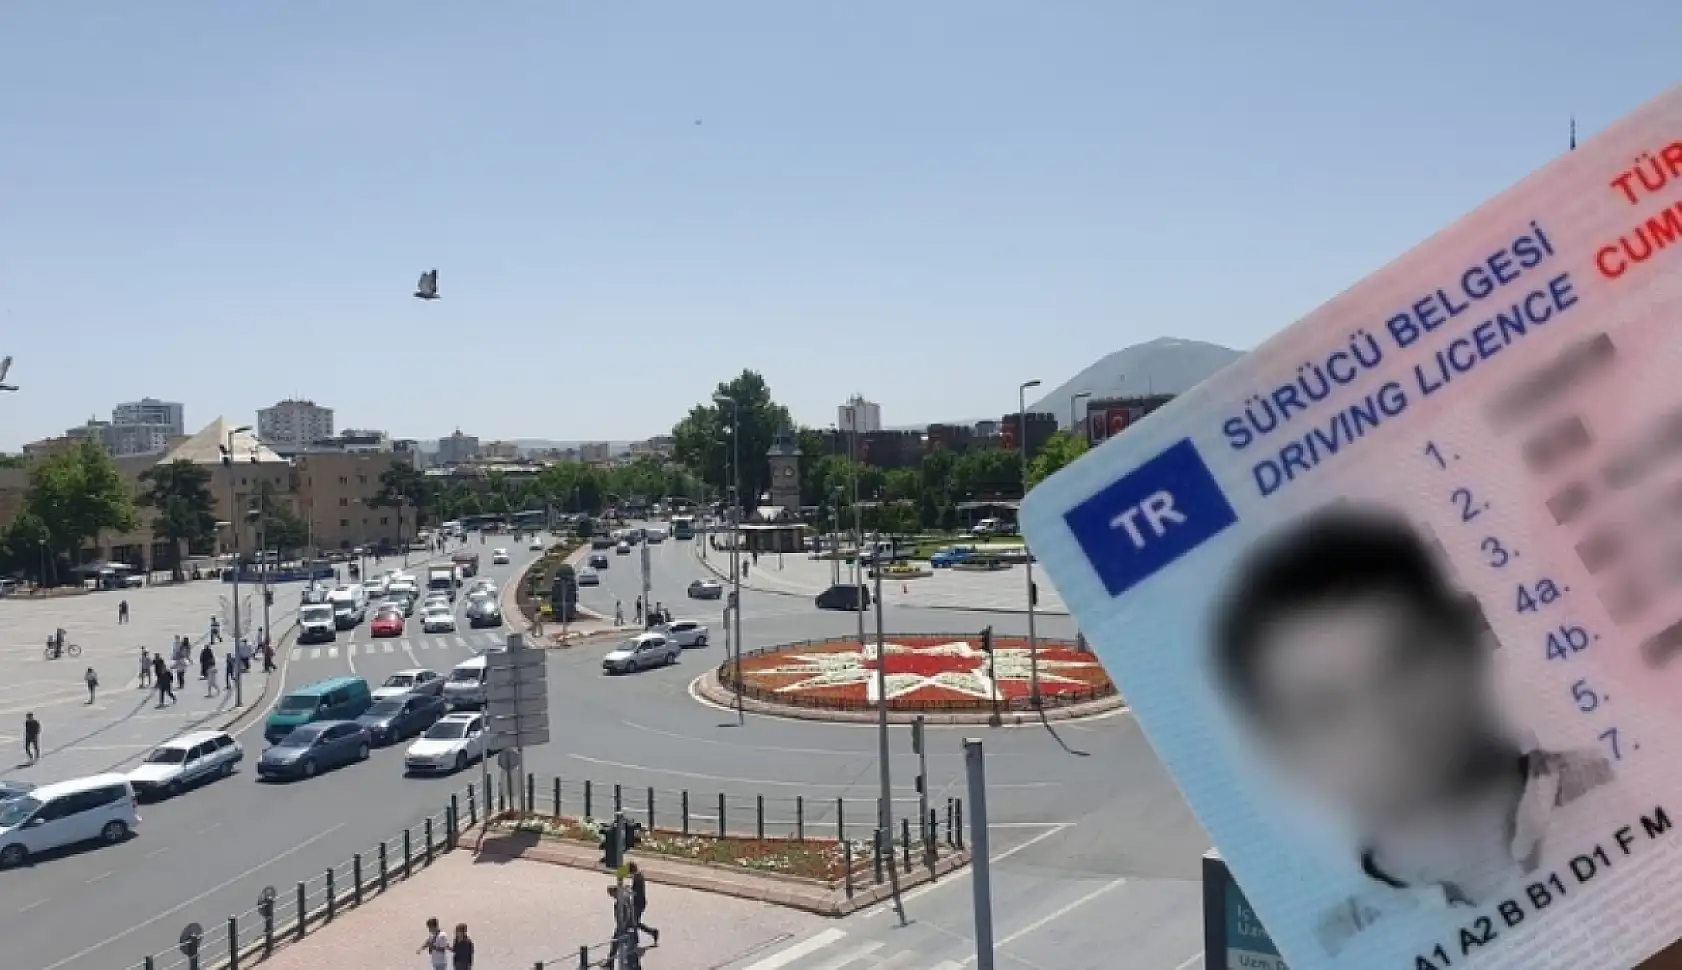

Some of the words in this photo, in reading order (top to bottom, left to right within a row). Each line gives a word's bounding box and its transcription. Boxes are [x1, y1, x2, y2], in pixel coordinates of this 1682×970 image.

[1223, 328, 1383, 450] SÜRÜCÜ
[1386, 220, 1555, 349] BELGESİ
[1253, 381, 1408, 496] DRIVING
[1414, 272, 1579, 396] LICENCE
[1425, 440, 1461, 470] 1.
[1109, 490, 1188, 548] TR
[1450, 487, 1489, 522] 2.
[1480, 536, 1520, 568] 3.
[1516, 577, 1570, 613] 4a.
[1546, 624, 1600, 660] 4b.
[1571, 679, 1610, 712] 5.
[1598, 726, 1640, 761] 7.
[1415, 942, 1451, 970] A1
[1459, 916, 1498, 956] A2
[1497, 900, 1525, 927] B
[1526, 873, 1567, 910] B1
[1569, 844, 1612, 883] D1
[1613, 824, 1635, 855] F
[1640, 806, 1673, 840] M
